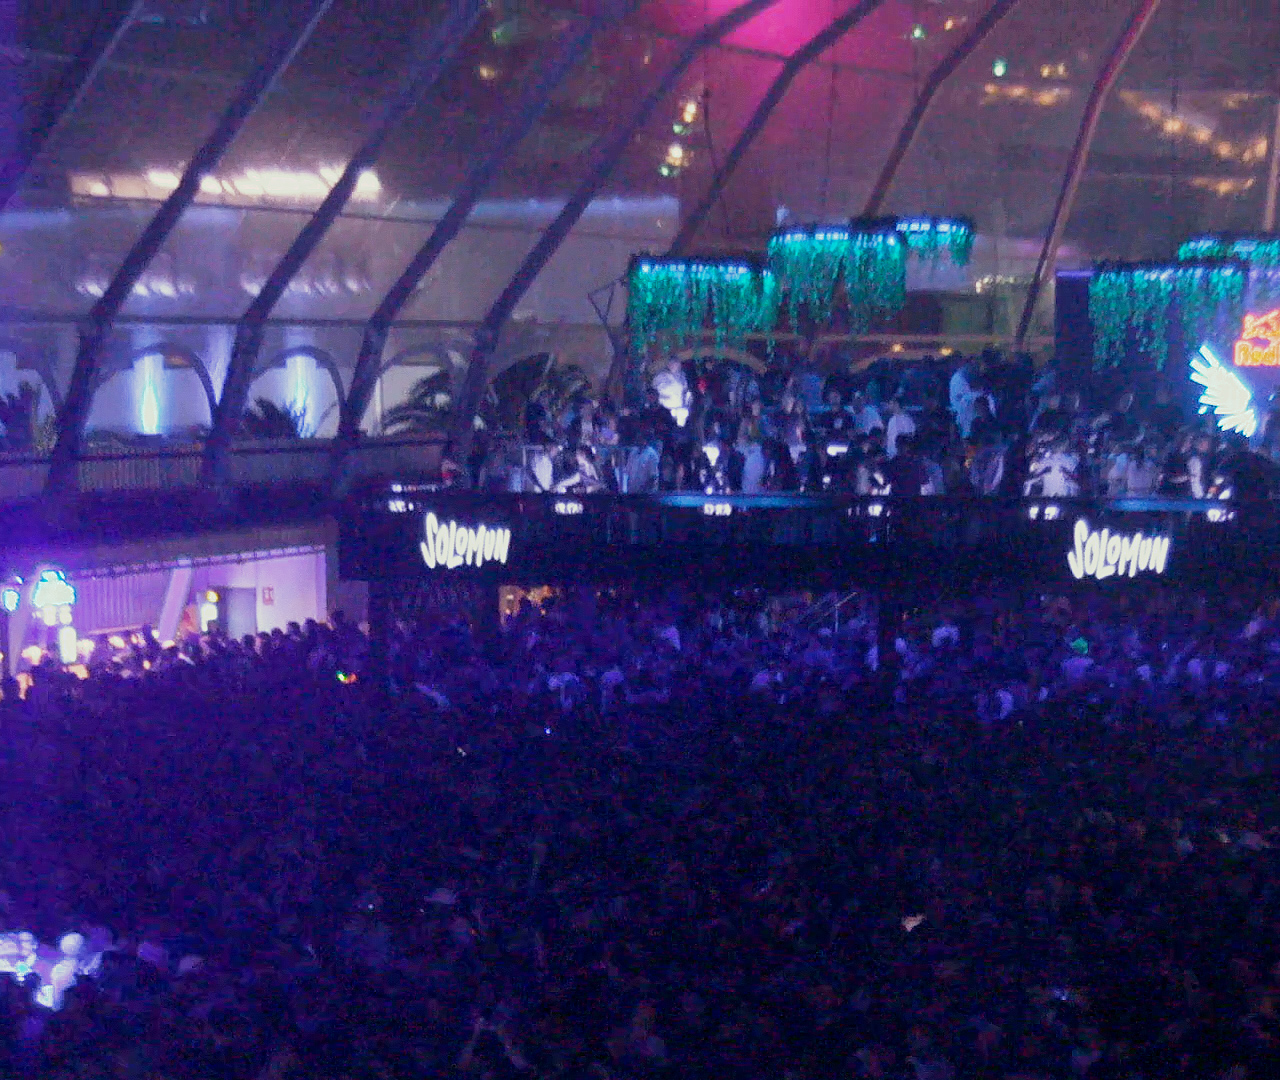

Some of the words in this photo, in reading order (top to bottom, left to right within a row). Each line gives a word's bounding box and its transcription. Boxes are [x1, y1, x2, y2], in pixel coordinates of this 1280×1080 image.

[1235, 340, 1277, 366] Red
[420, 511, 511, 570] SOLOMUN
[1067, 518, 1170, 581] SOLOMUN
